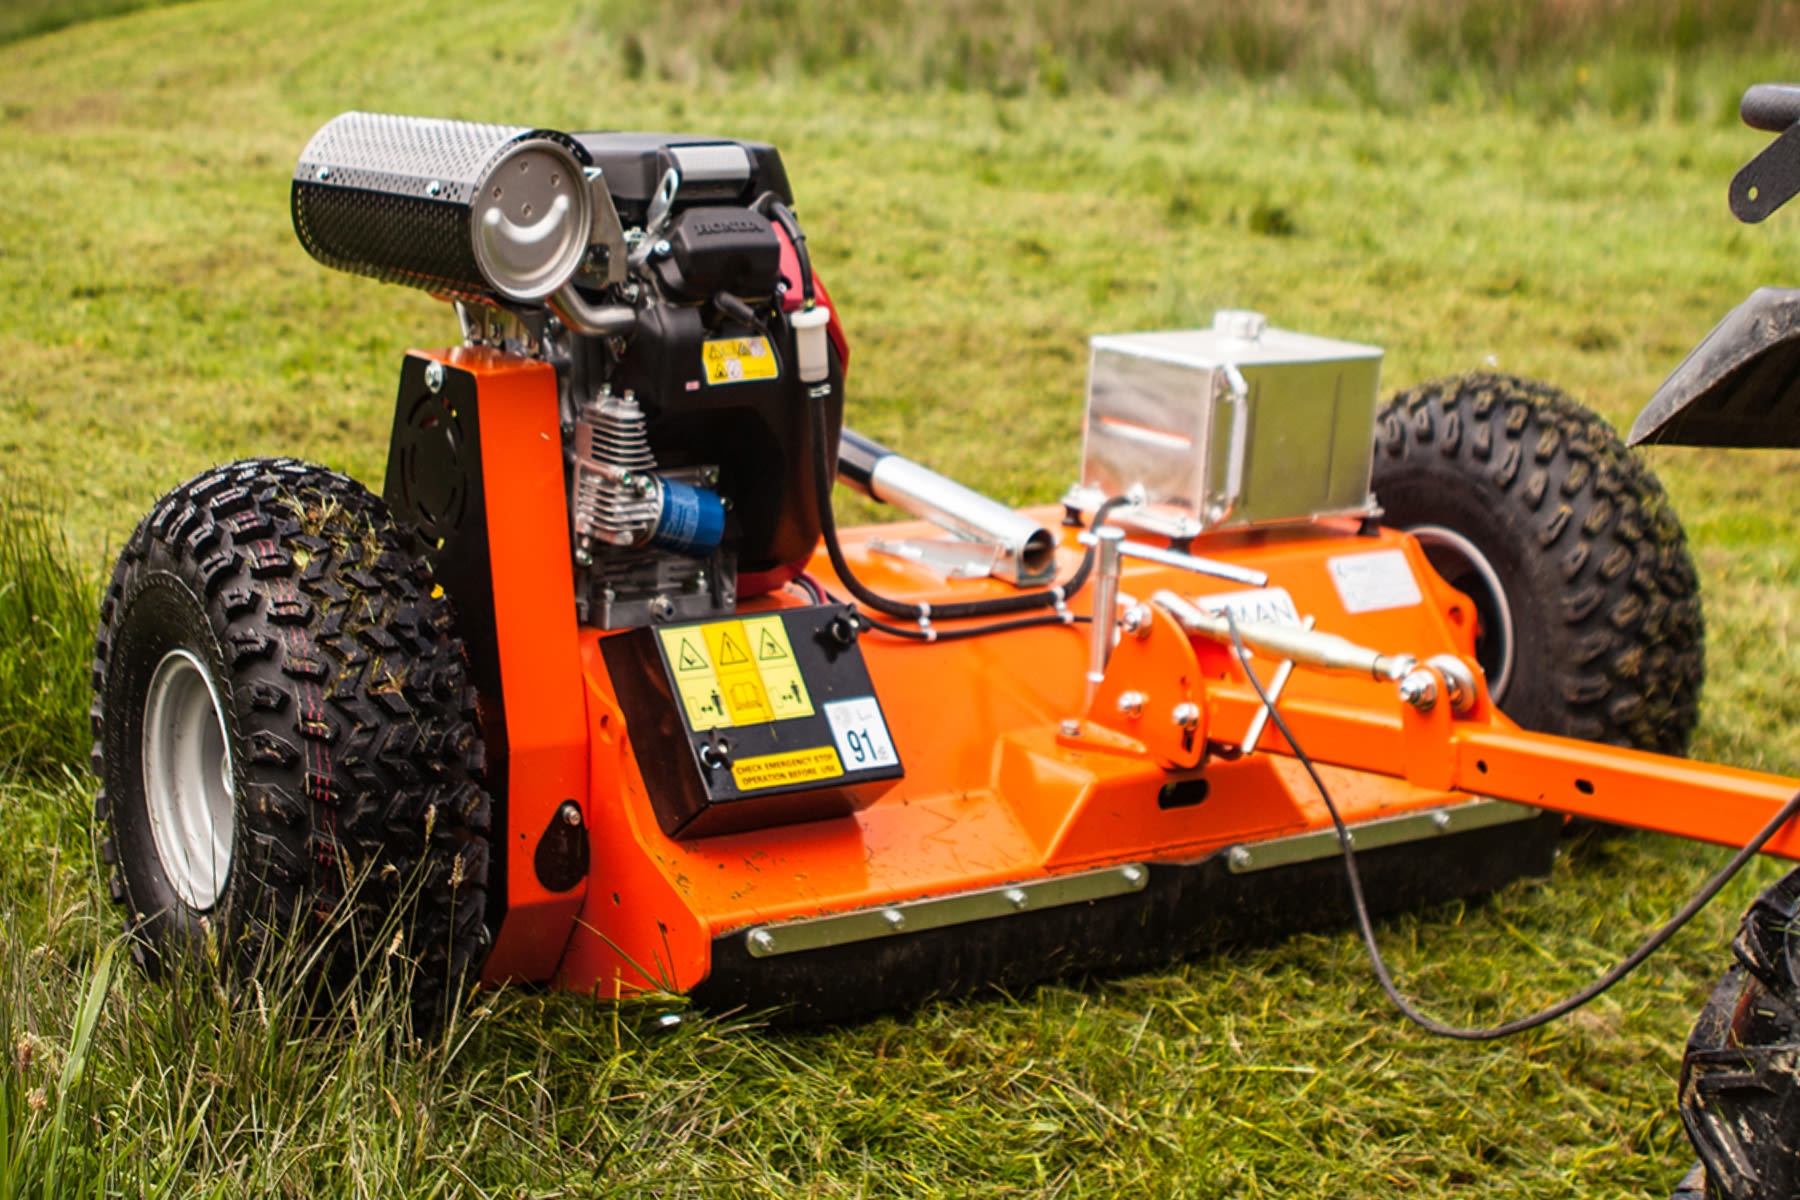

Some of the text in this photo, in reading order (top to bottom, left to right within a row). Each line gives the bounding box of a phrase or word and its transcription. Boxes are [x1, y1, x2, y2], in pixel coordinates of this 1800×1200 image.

[694, 221, 765, 236] HONDA
[847, 728, 877, 763] 91
[735, 753, 833, 775] CHECK EMERGENCY STOP
[742, 764, 837, 786] OPERATION BEFORE USE
